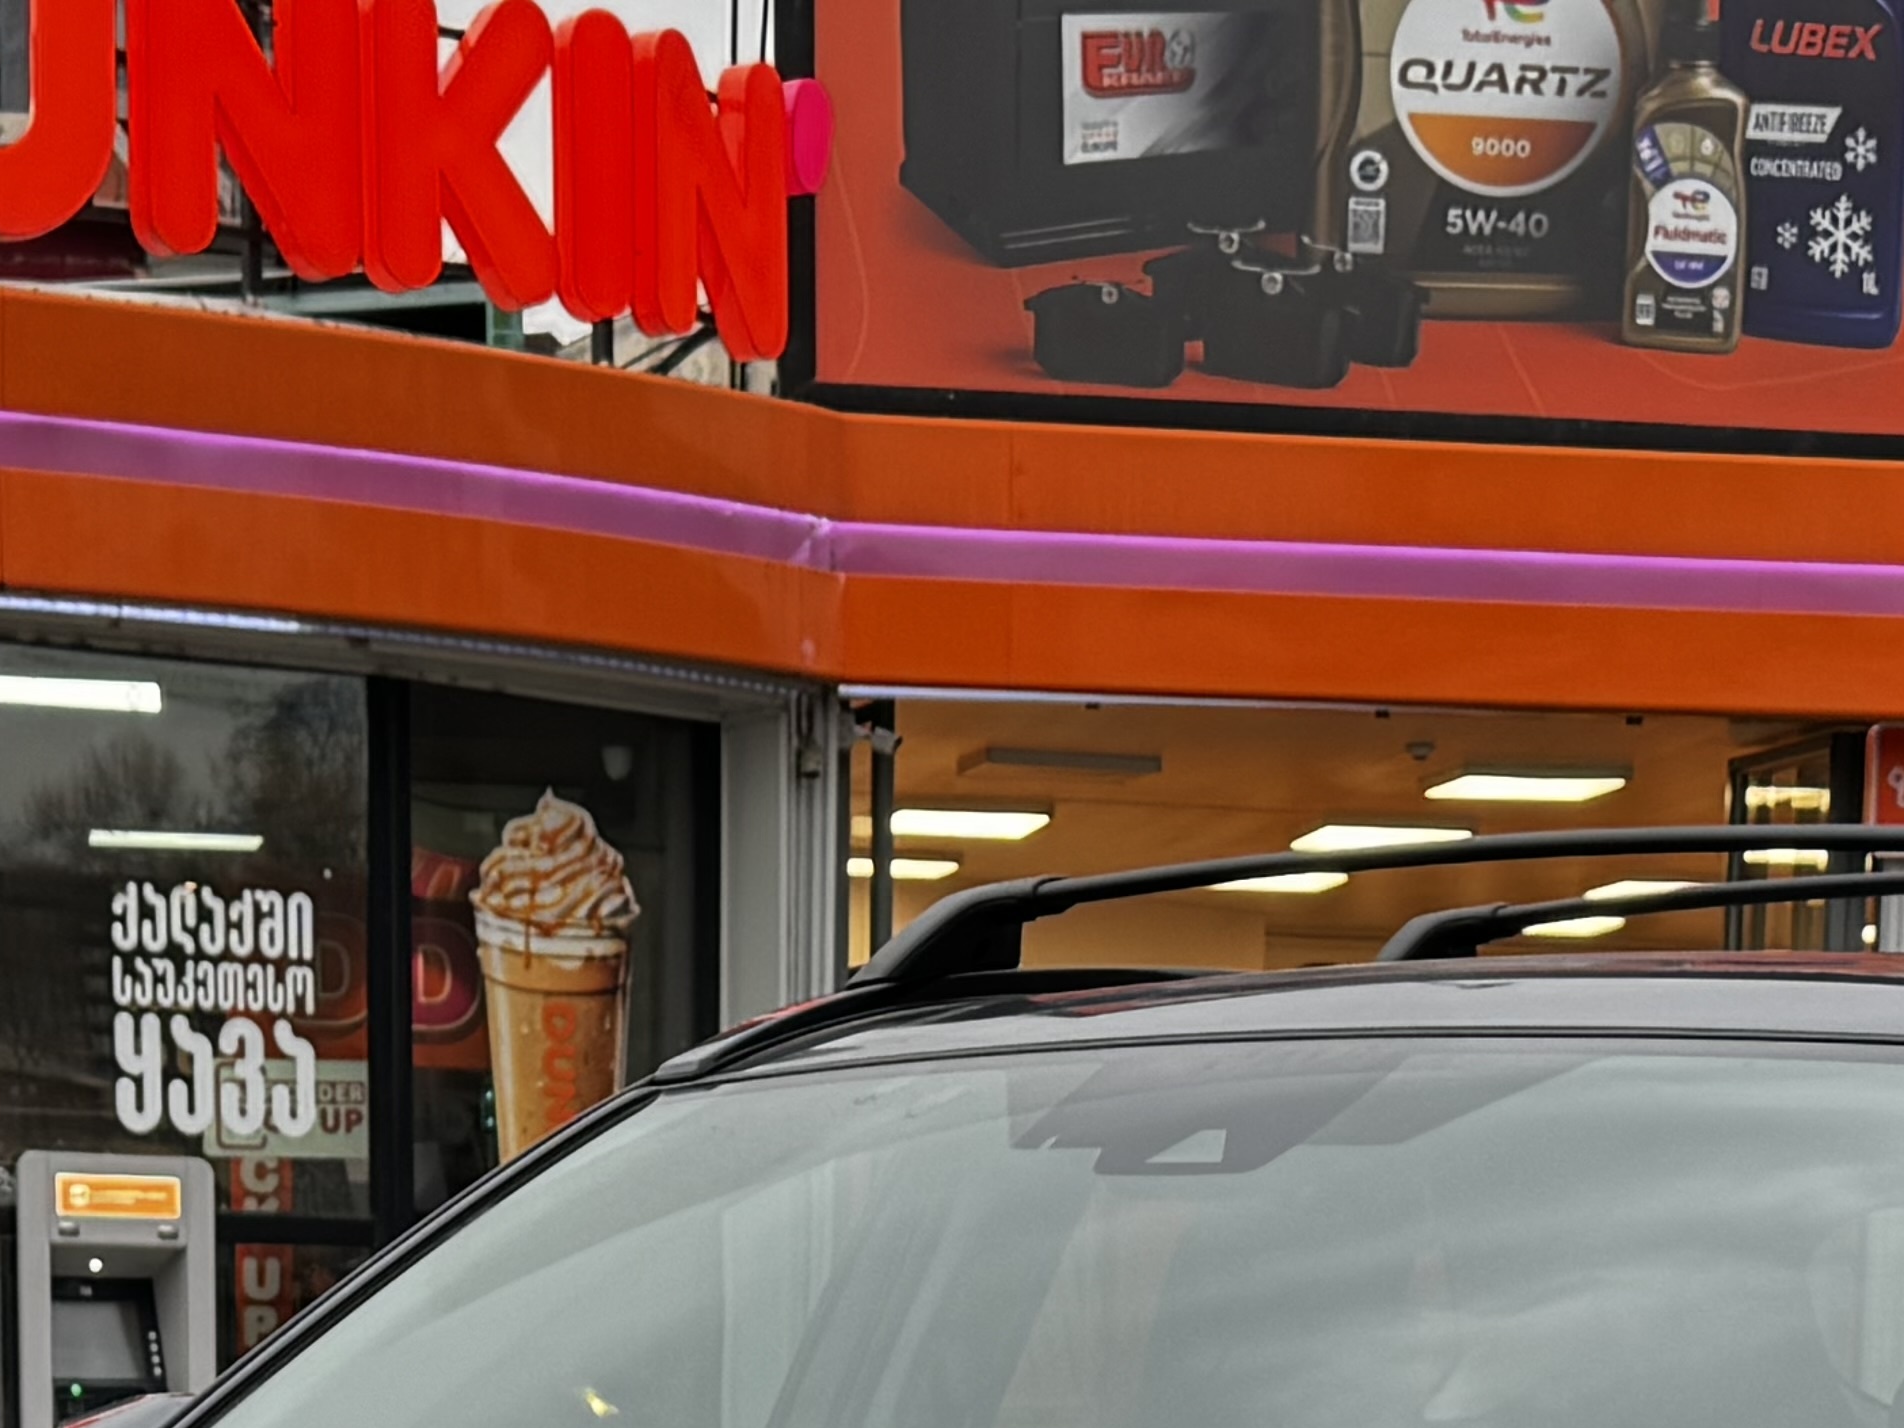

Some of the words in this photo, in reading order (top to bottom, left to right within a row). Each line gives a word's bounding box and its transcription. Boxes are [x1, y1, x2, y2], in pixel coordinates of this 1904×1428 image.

[1749, 18, 1884, 62] LUBEX
[1398, 57, 1612, 99] QUARTZ
[1471, 136, 1531, 158] 9000
[1749, 156, 1844, 182] CONCENTRATED
[1445, 206, 1550, 239] 5W-40
[111, 954, 315, 1016] საუკეთესო
[113, 1011, 316, 1138] ყავა
[319, 1107, 364, 1136] UP
